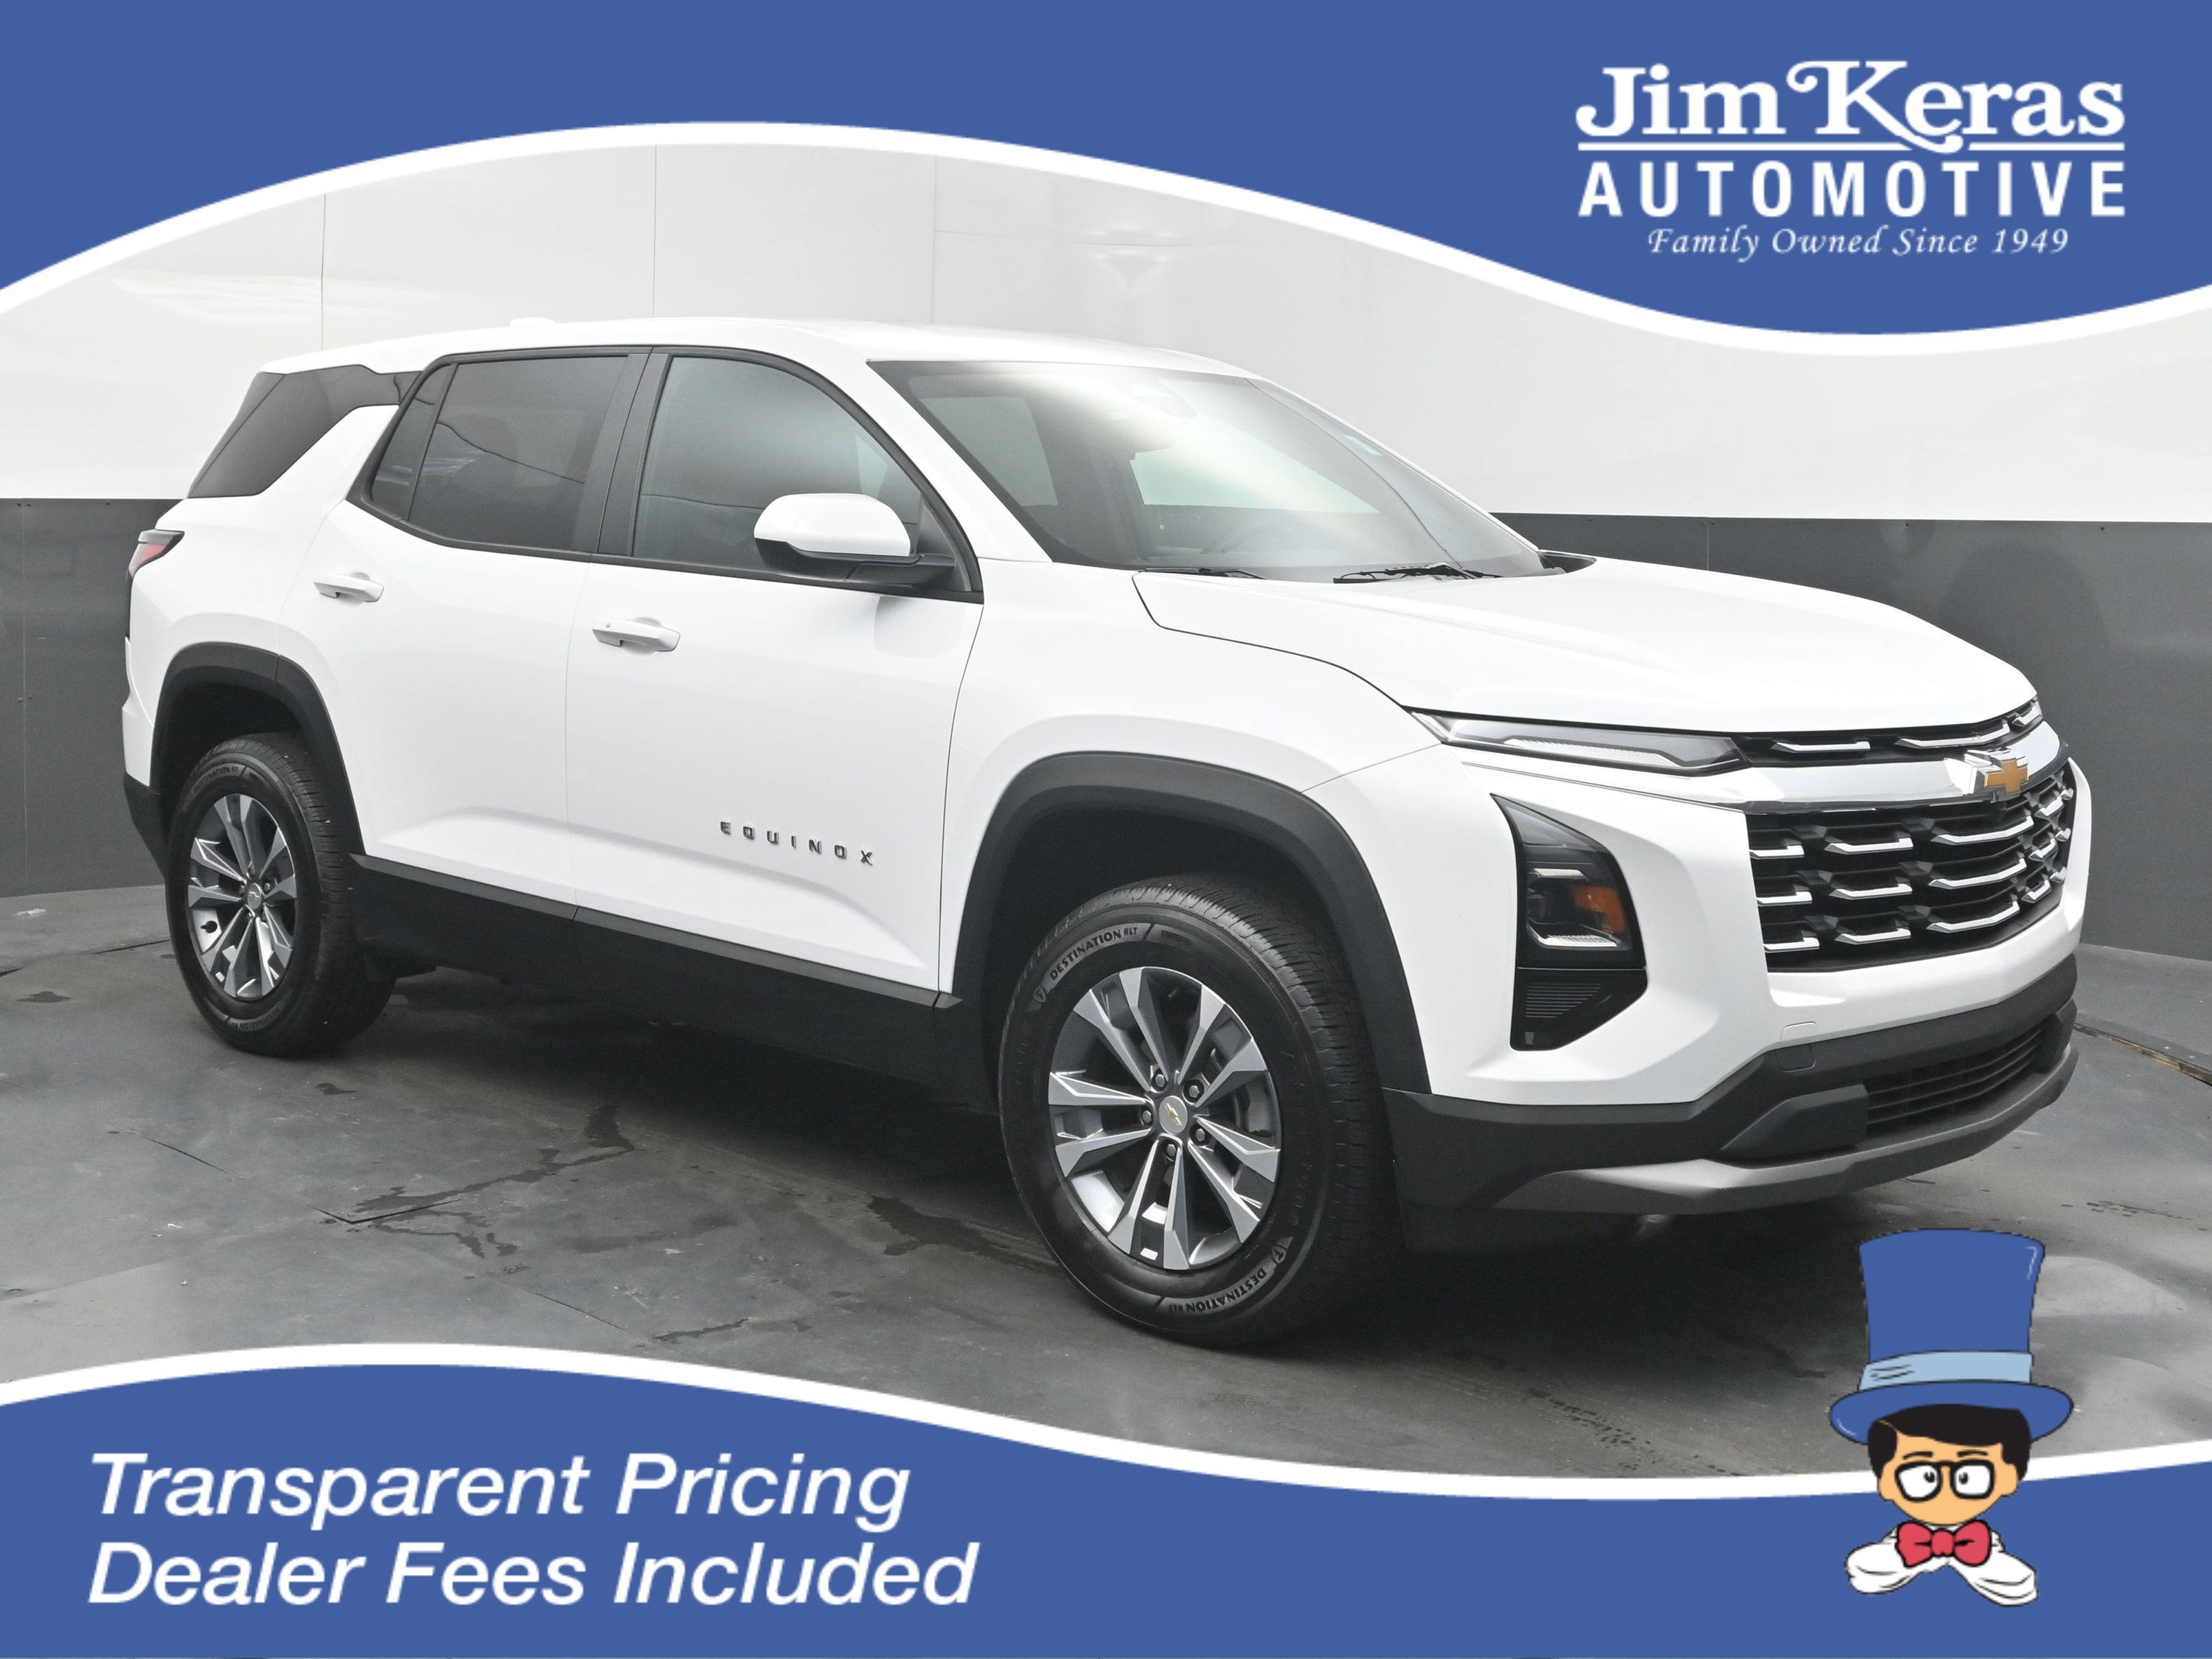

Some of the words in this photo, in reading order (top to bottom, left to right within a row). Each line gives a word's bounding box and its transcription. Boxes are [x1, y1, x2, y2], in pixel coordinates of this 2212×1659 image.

[720, 819, 874, 866] EQUINOX
[1050, 929, 1121, 981] DESTINATION
[1186, 1267, 1267, 1313] DESTINATION
